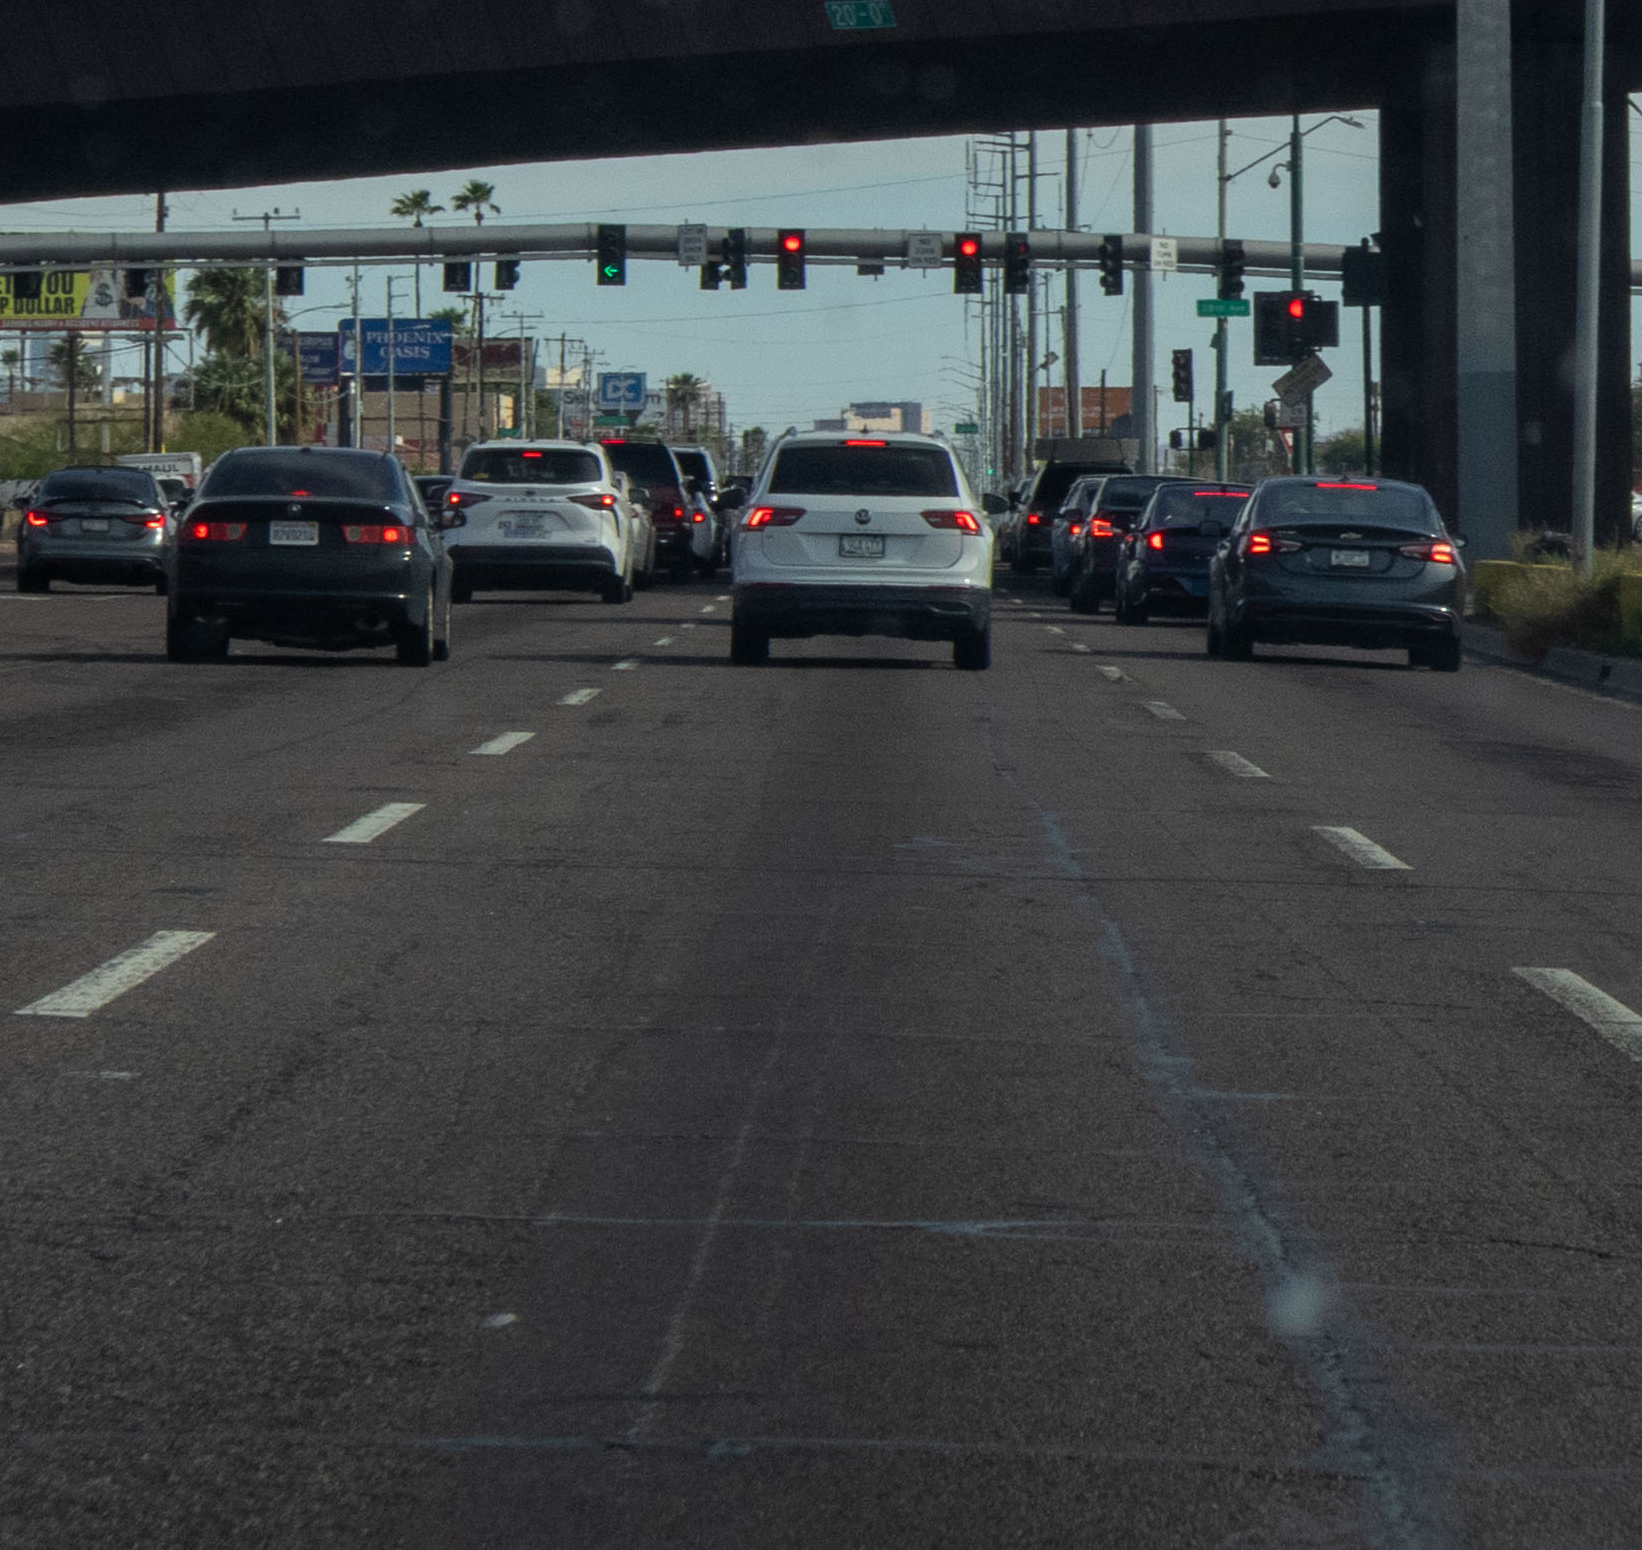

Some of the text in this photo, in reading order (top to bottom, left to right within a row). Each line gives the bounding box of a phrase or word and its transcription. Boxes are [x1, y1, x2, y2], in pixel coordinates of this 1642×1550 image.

[14, 297, 75, 315] DOLLAR
[366, 331, 446, 344] PHOENIX
[379, 345, 431, 359] OASIS
